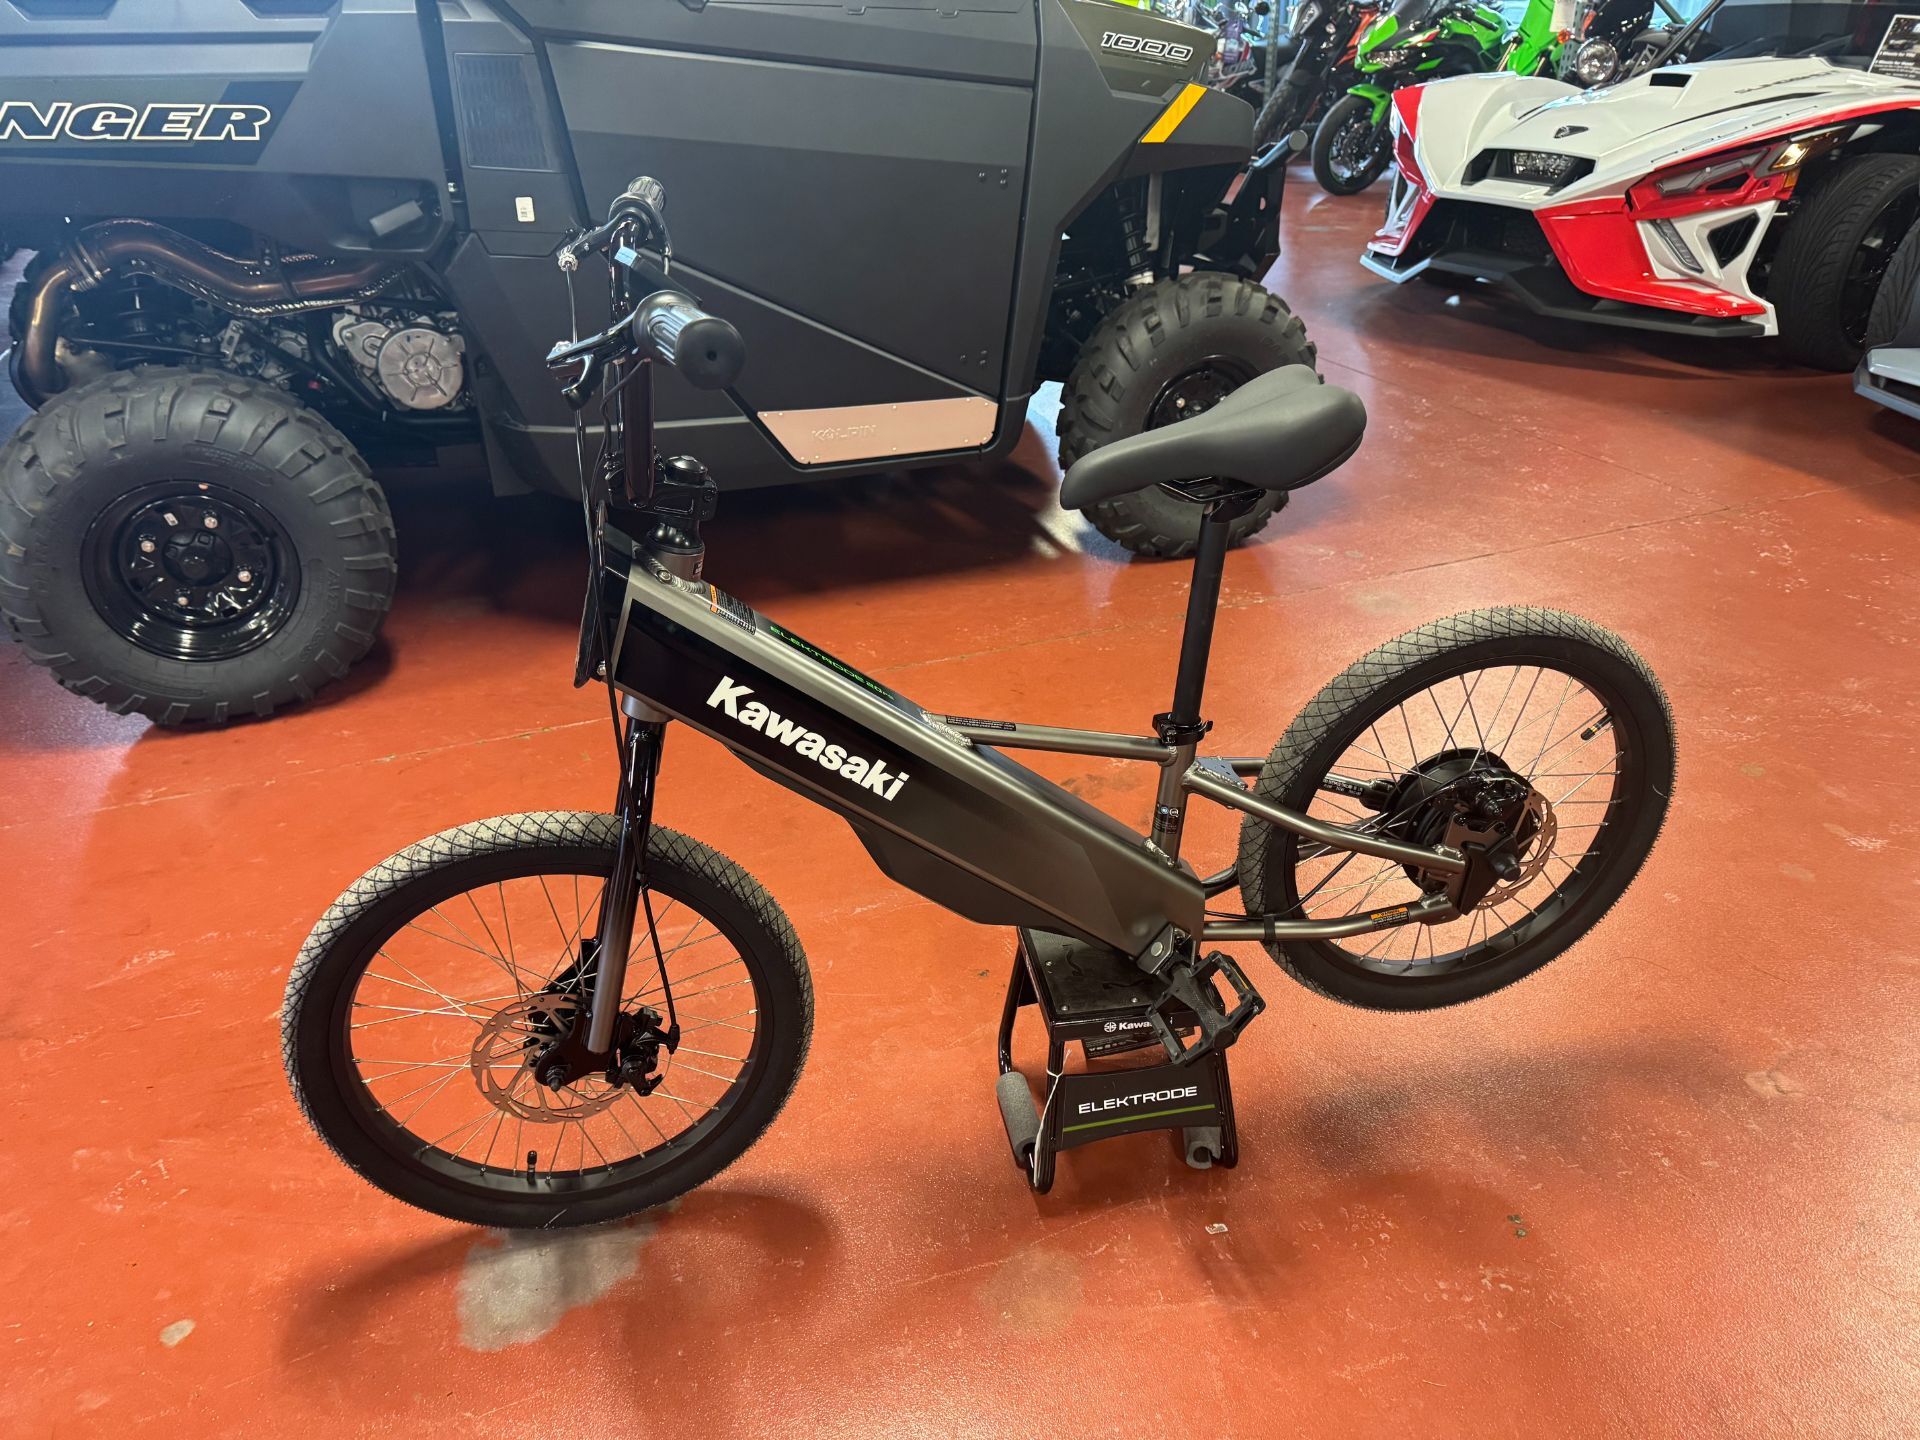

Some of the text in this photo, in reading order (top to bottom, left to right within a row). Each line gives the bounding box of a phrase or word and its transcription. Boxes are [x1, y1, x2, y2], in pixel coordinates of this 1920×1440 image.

[1101, 31, 1193, 61] 1000
[0, 101, 271, 140] NGER
[706, 675, 910, 801] Kawasaki
[1078, 1086, 1198, 1114] ELEKTRODE
